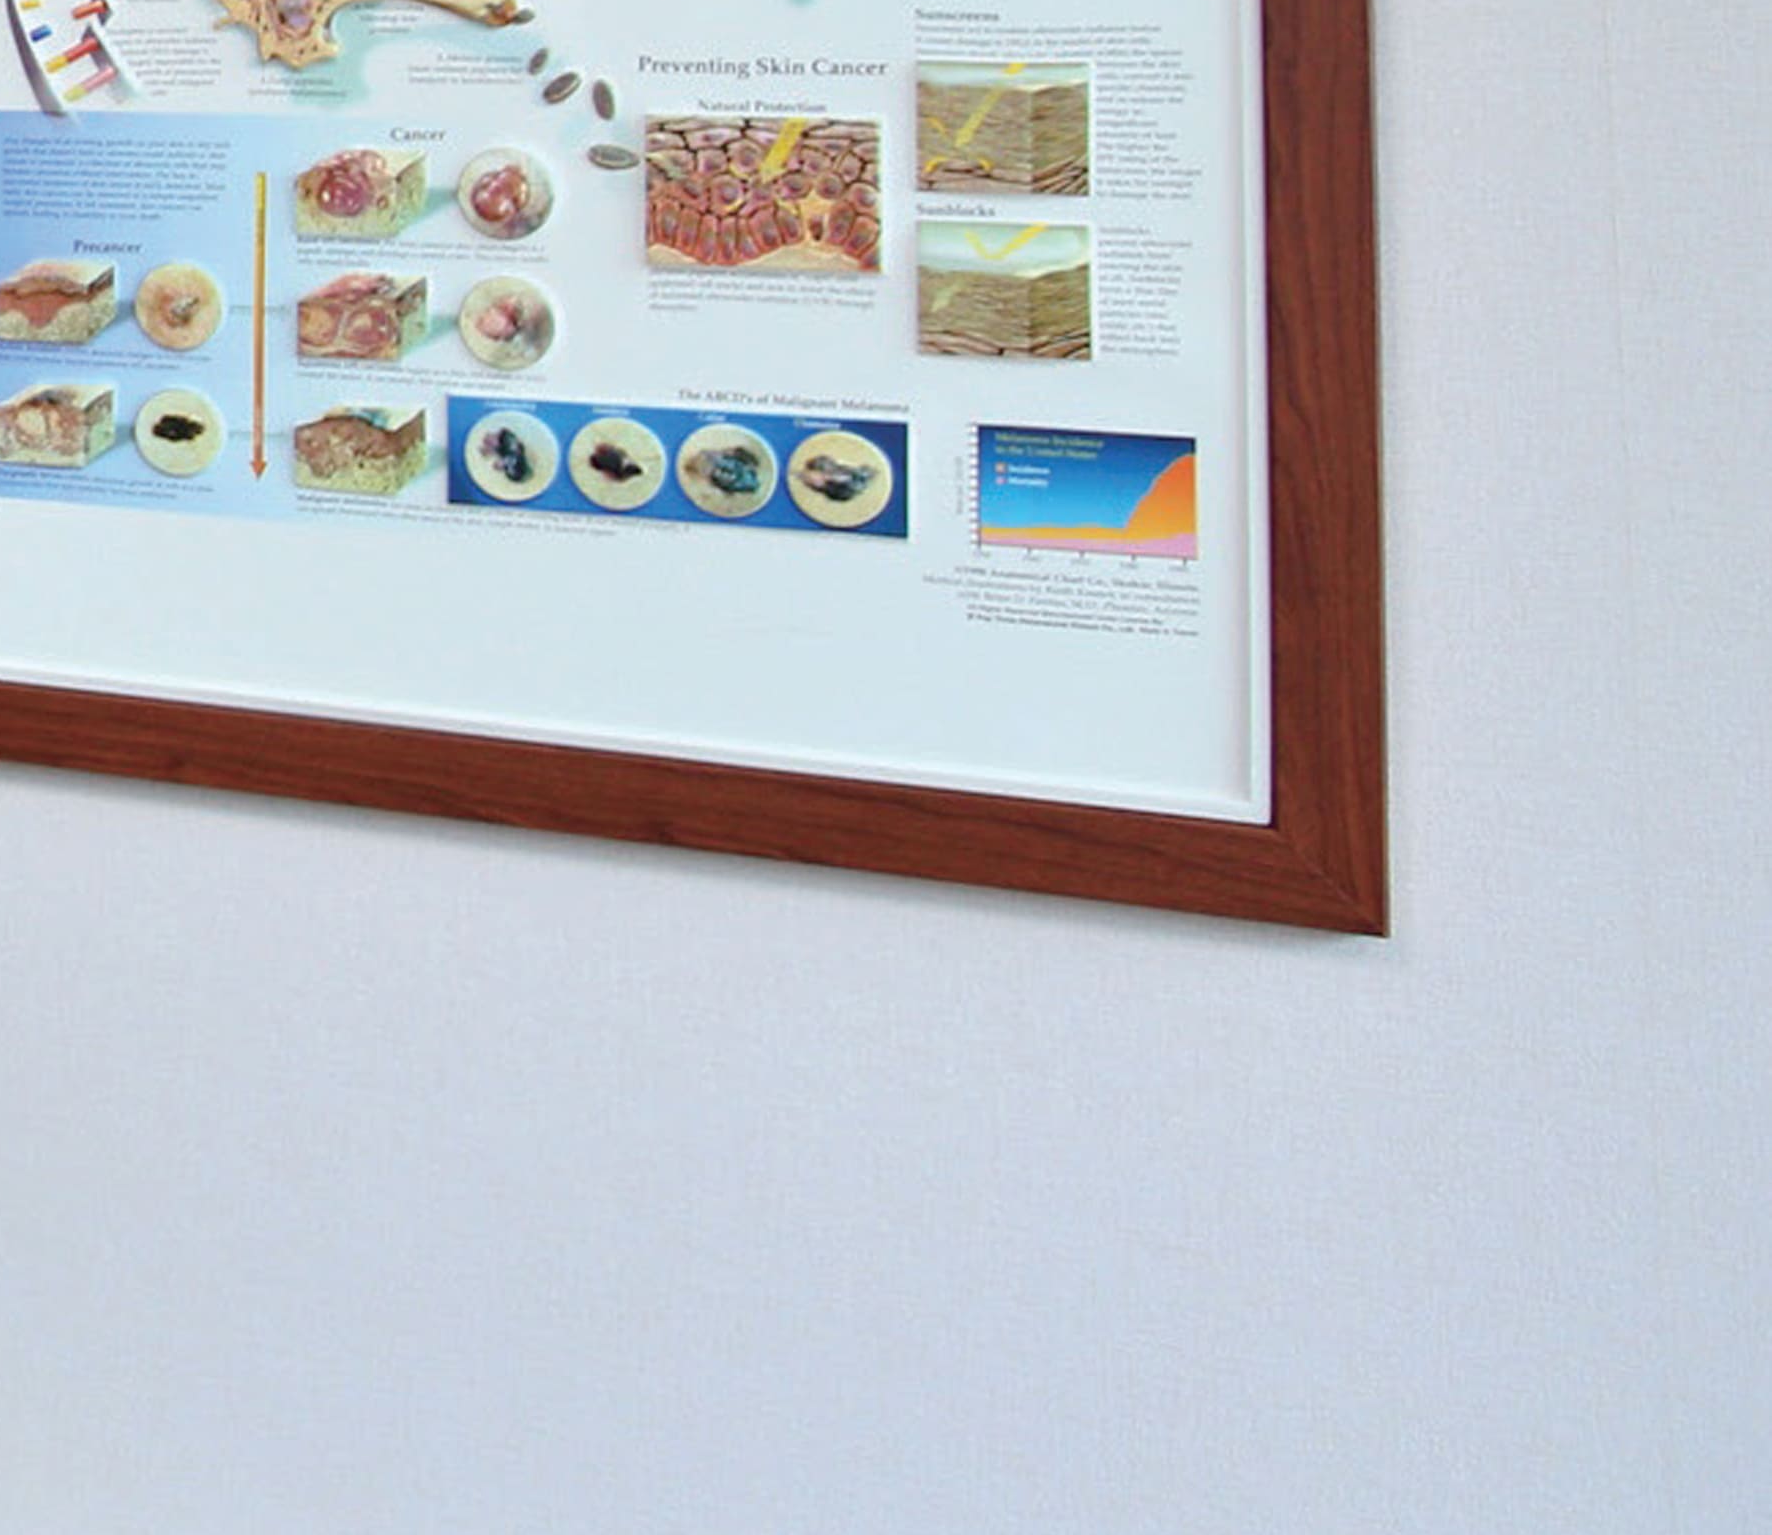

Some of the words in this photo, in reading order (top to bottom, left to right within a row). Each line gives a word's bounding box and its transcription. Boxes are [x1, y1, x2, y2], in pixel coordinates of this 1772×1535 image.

[637, 56, 750, 79] Preventing
[754, 57, 806, 76] Skin
[811, 59, 889, 76] Cancer
[698, 99, 750, 112] Natural
[754, 100, 827, 113] Protection
[389, 126, 446, 142] Cancer
[72, 238, 142, 254] Precancer
